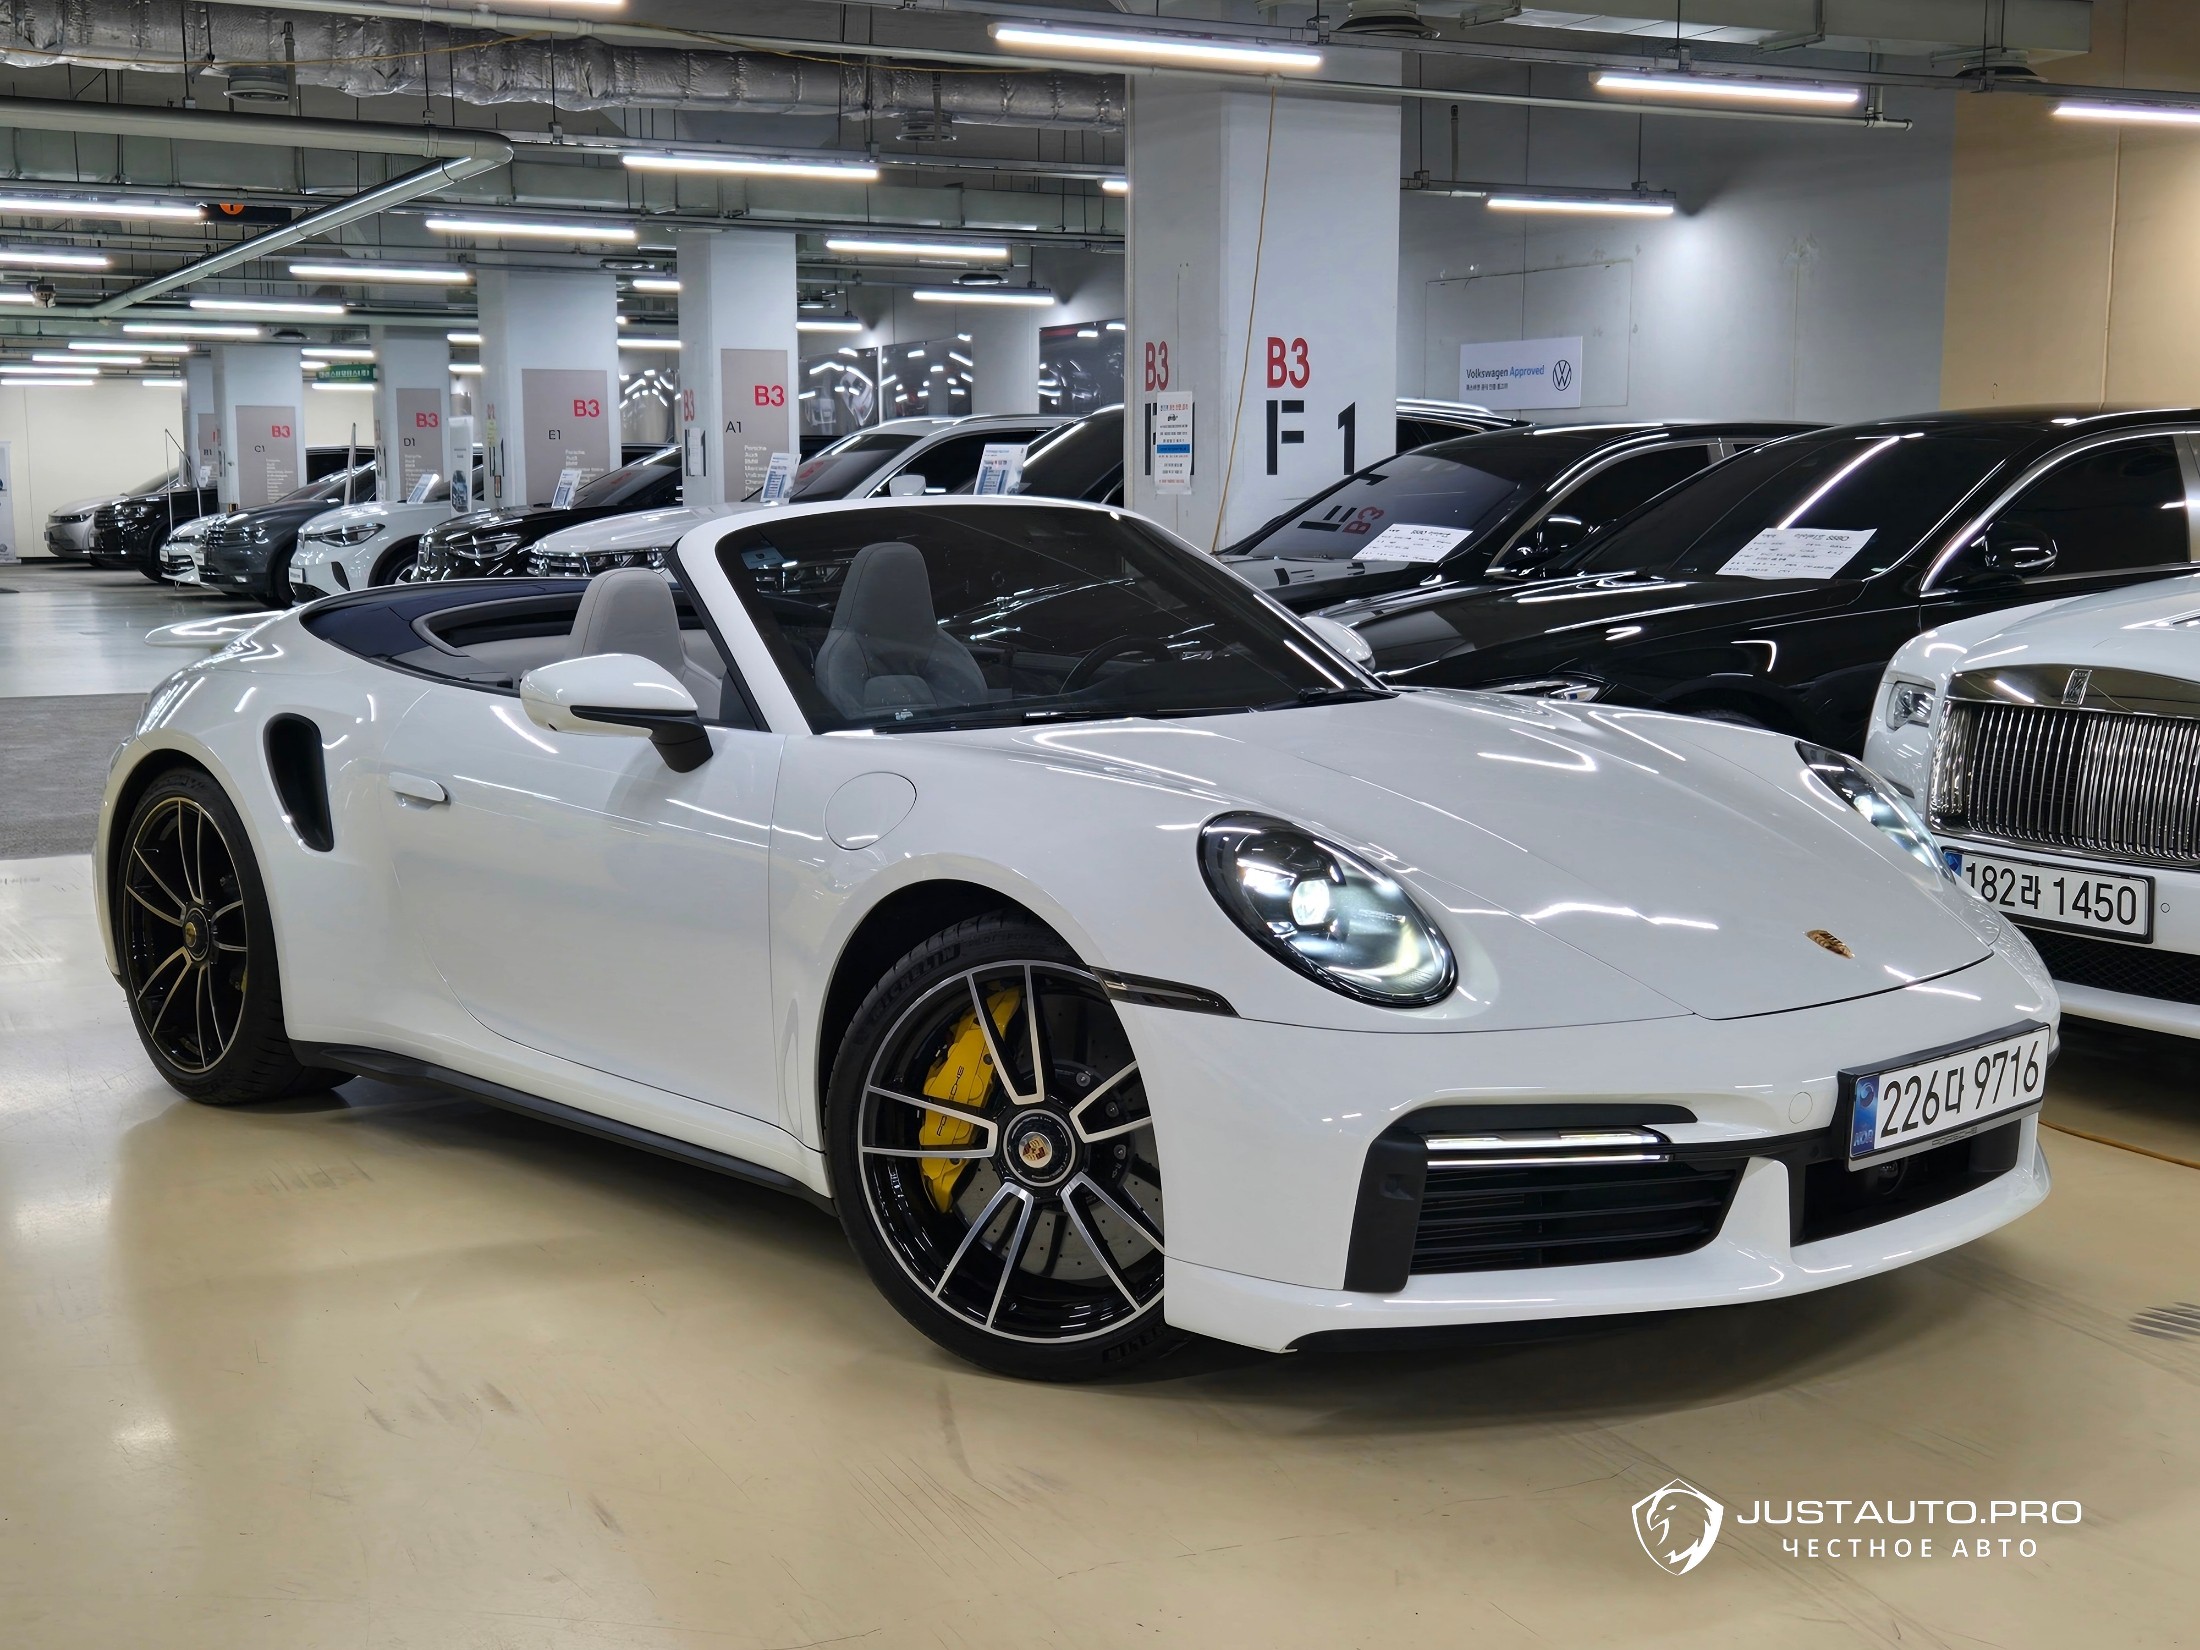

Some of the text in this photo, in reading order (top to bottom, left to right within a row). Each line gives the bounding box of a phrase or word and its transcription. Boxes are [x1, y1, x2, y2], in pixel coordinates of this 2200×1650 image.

[1145, 341, 1169, 391] B3
[1266, 337, 1310, 389] B3
[1466, 364, 1545, 380] Volkswagen Approved
[684, 389, 695, 421] B3
[754, 385, 785, 407] B3
[573, 399, 600, 418] B3
[415, 412, 439, 428] B3
[725, 421, 742, 433] A1
[271, 425, 291, 438] B3
[548, 429, 561, 440] E1
[1266, 400, 1305, 475] F
[1337, 402, 1356, 475] 1
[254, 445, 265, 453] C1
[403, 438, 416, 447] D1
[1965, 862, 2138, 927] 182라 1450
[1879, 1040, 2040, 1139] 226다 9716
[936, 1065, 965, 1137] POCHE
[1853, 1129, 1874, 1147] KOR
